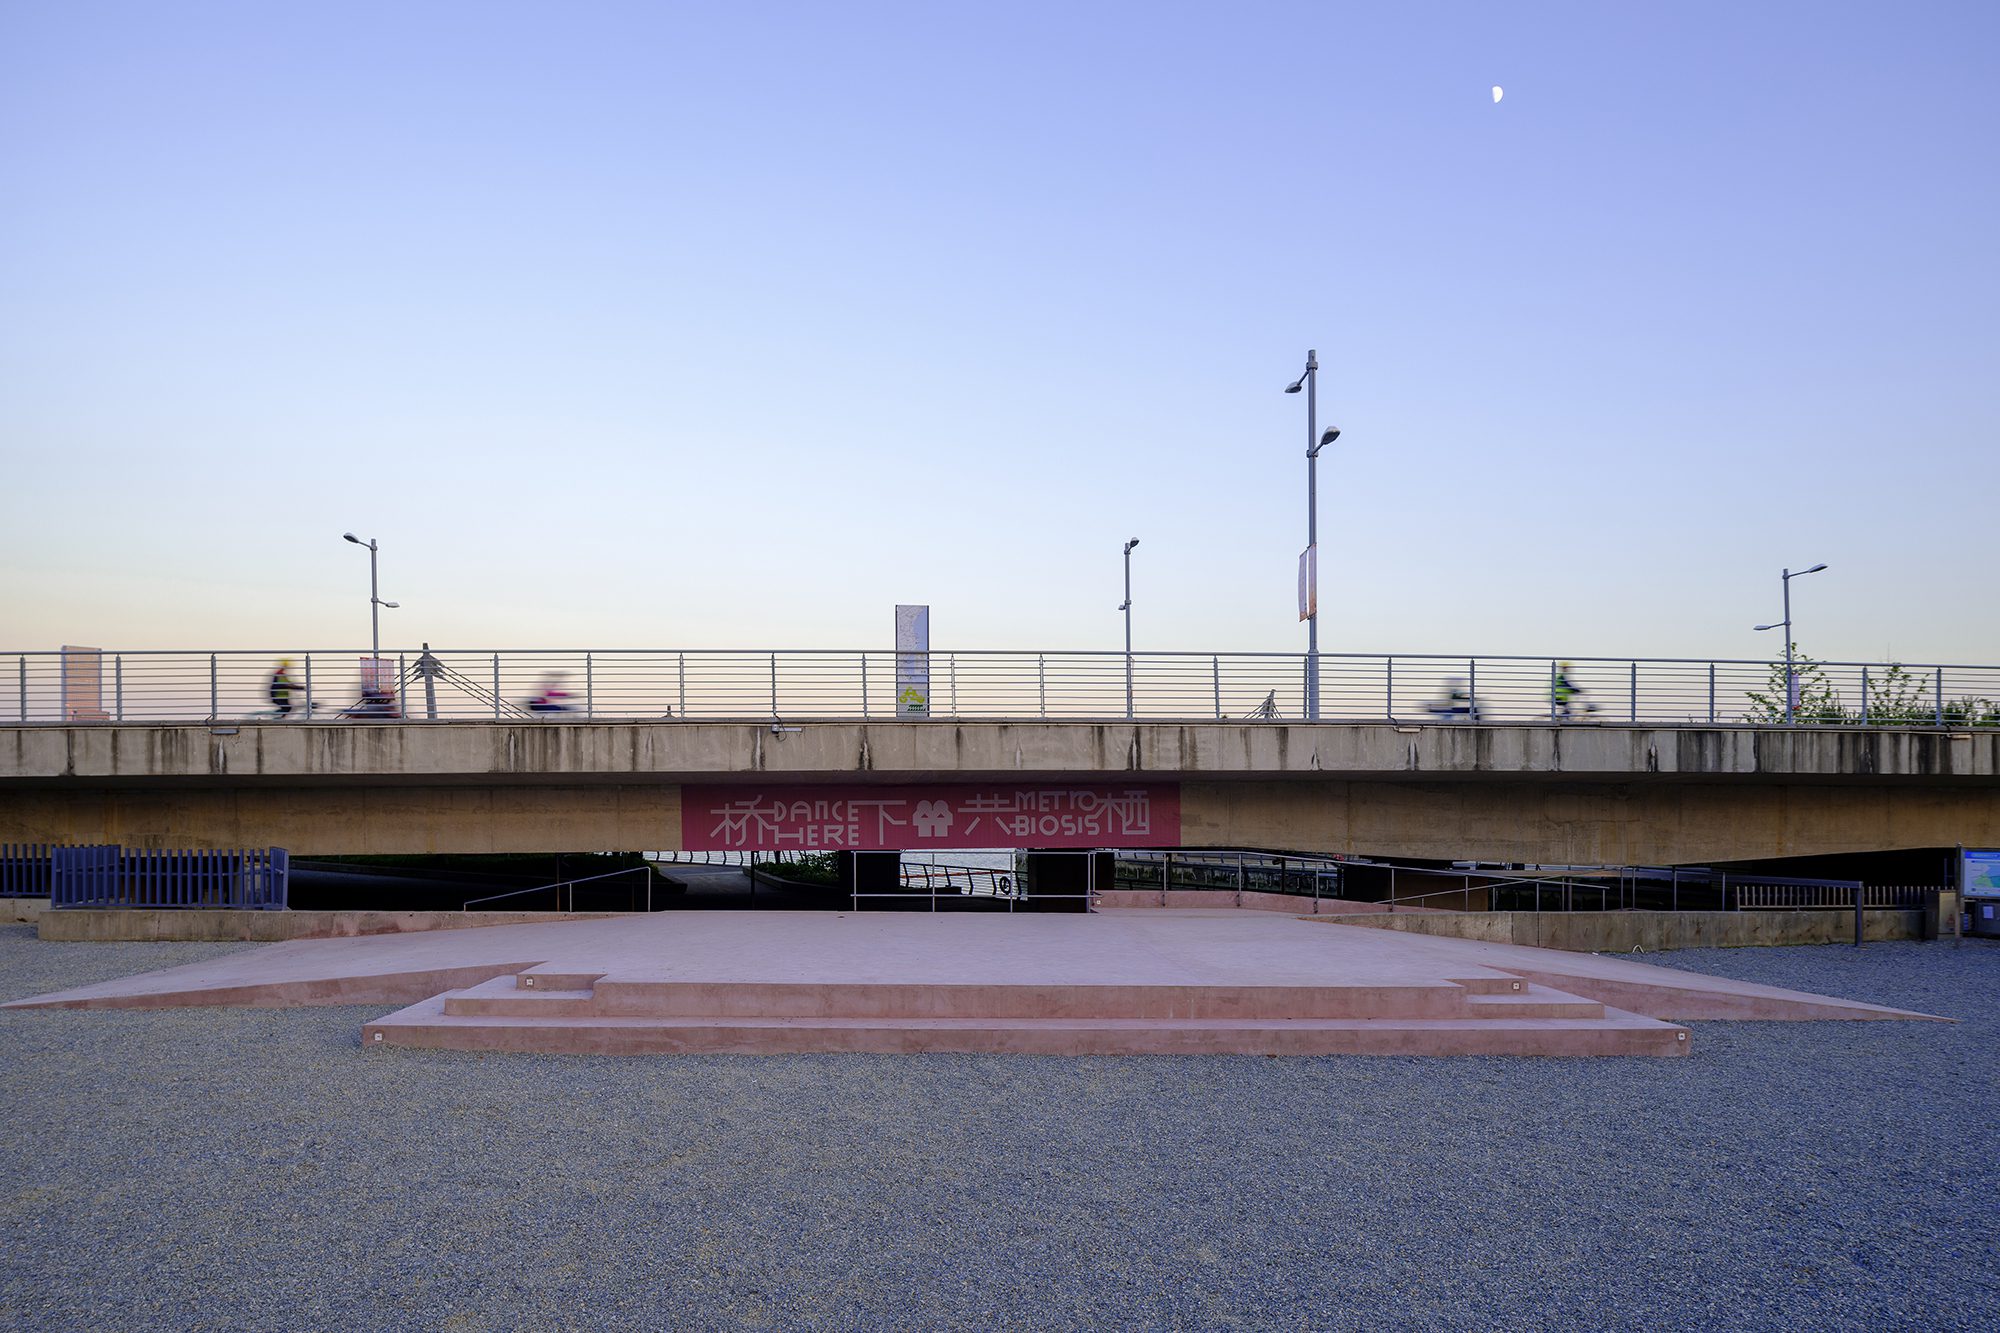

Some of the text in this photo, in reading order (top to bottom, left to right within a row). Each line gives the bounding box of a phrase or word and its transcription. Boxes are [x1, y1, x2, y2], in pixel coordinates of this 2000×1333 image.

[711, 795, 776, 846] 桥
[775, 800, 859, 821] DANCE
[850, 800, 907, 845] 下
[958, 793, 1019, 836] 共
[1015, 815, 1099, 836] BIOSIS
[1096, 790, 1150, 835] 栖
[775, 824, 859, 845] HERE
